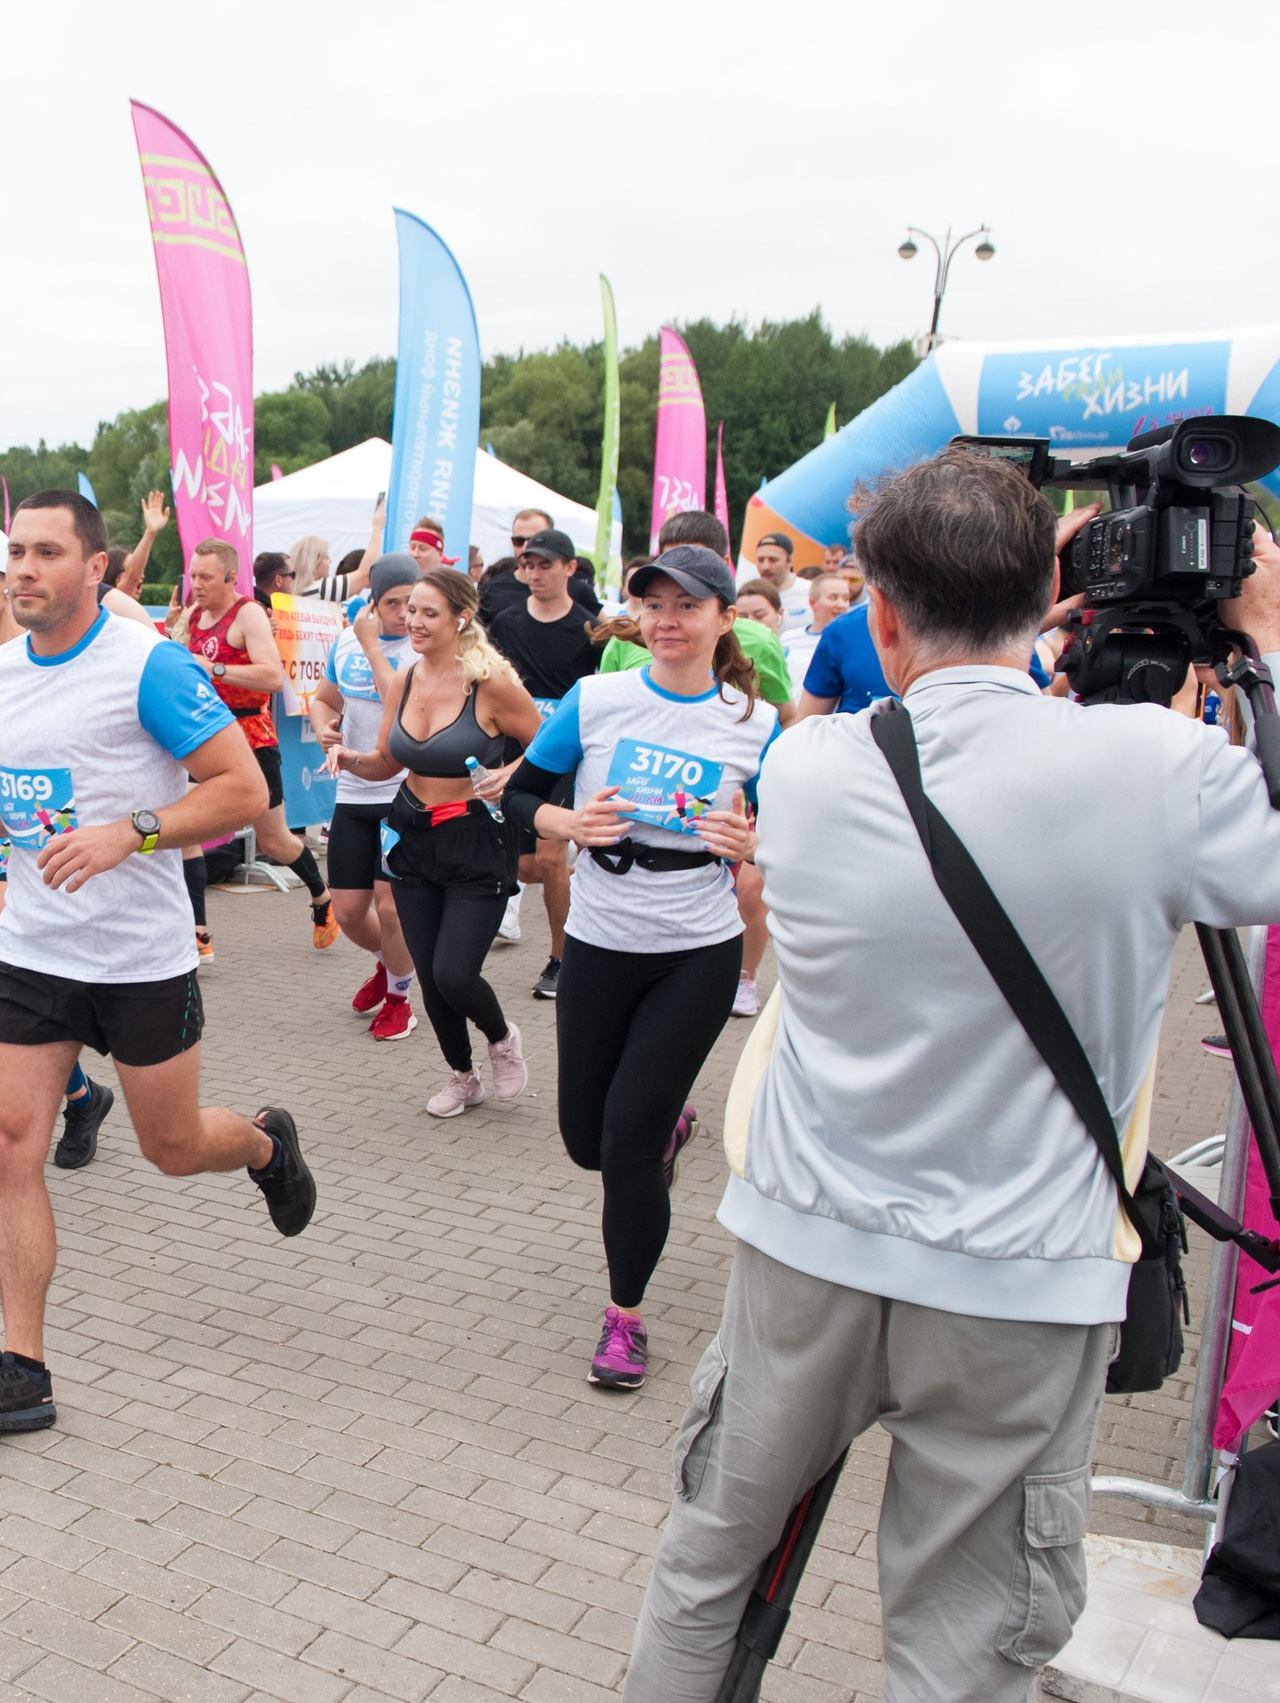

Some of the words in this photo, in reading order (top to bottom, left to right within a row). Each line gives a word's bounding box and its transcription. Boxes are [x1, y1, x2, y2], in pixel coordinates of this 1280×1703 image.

[1016, 353, 1112, 401] ЗАБЕГ
[1081, 367, 1189, 421] ЖИЗНИ
[289, 660, 297, 681] С
[0, 771, 53, 801] 3169
[629, 745, 703, 786] 3170
